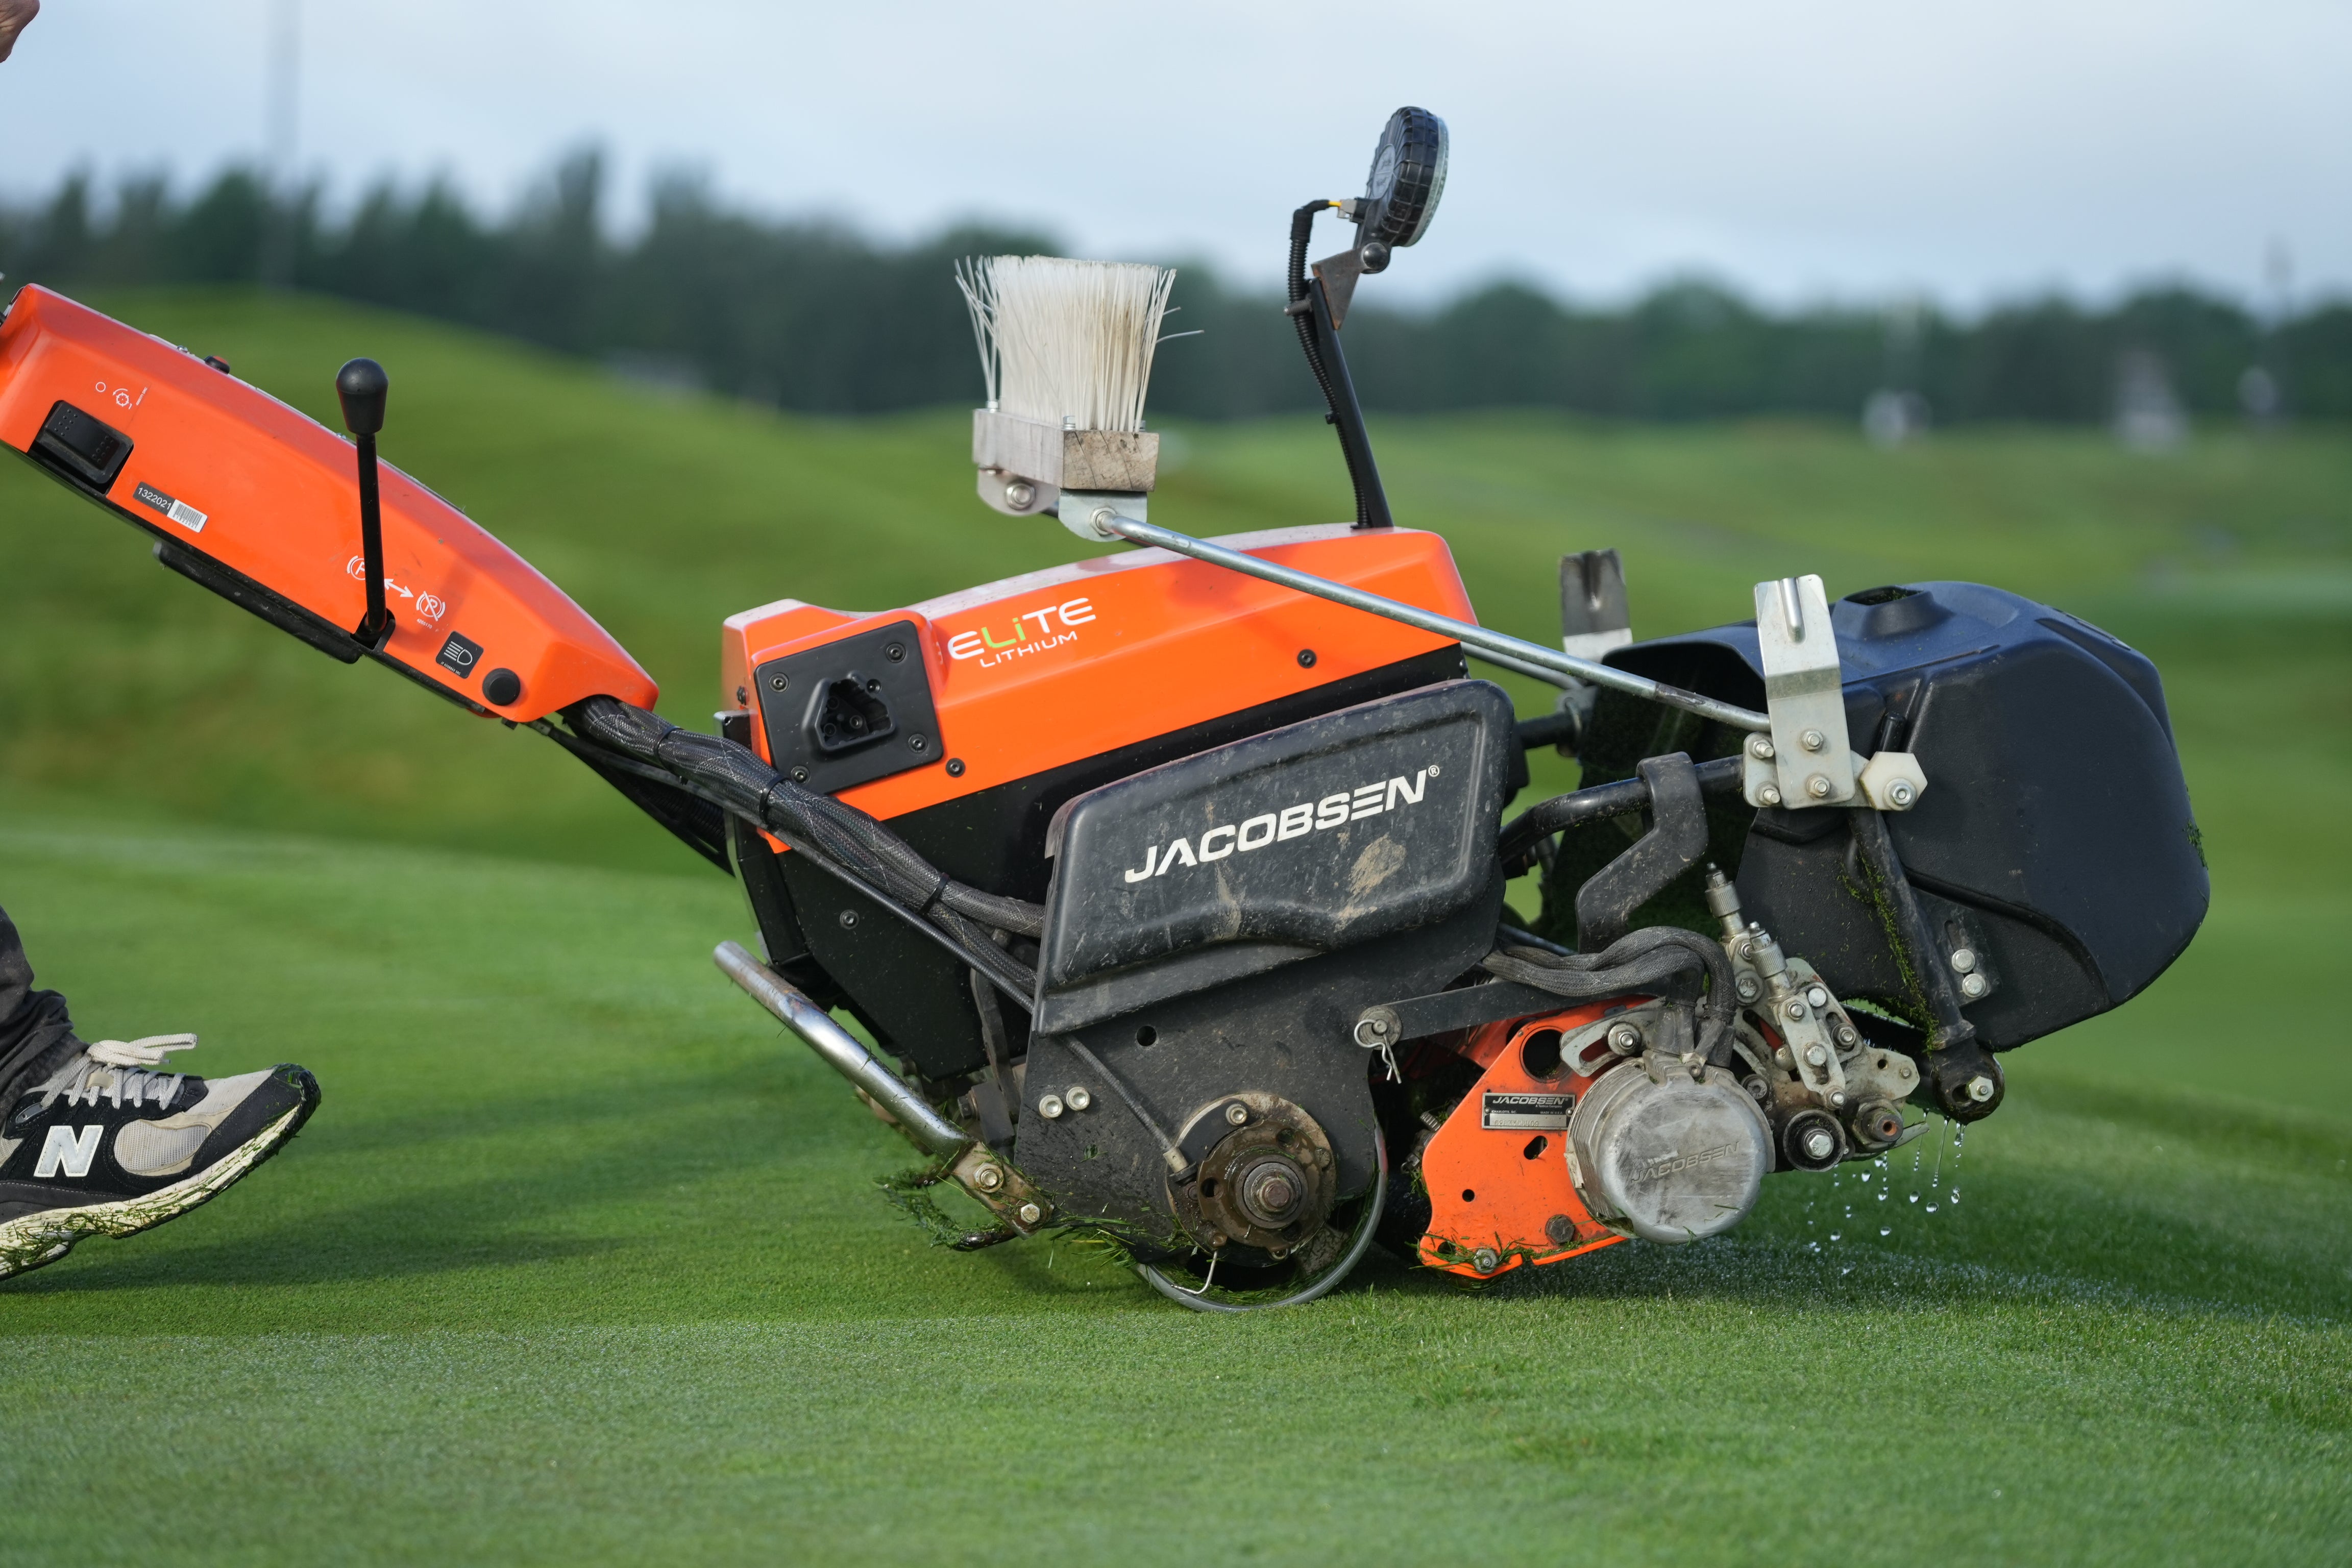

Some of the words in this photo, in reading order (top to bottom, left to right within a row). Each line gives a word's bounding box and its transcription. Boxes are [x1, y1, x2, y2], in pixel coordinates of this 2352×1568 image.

[138, 487, 172, 510] 1322021
[979, 631, 1078, 668] LITHIUM
[1492, 1096, 1565, 1105] JACOBSEN
[33, 1124, 104, 1178] N
[1631, 1141, 1739, 1183] JACOBSEN
